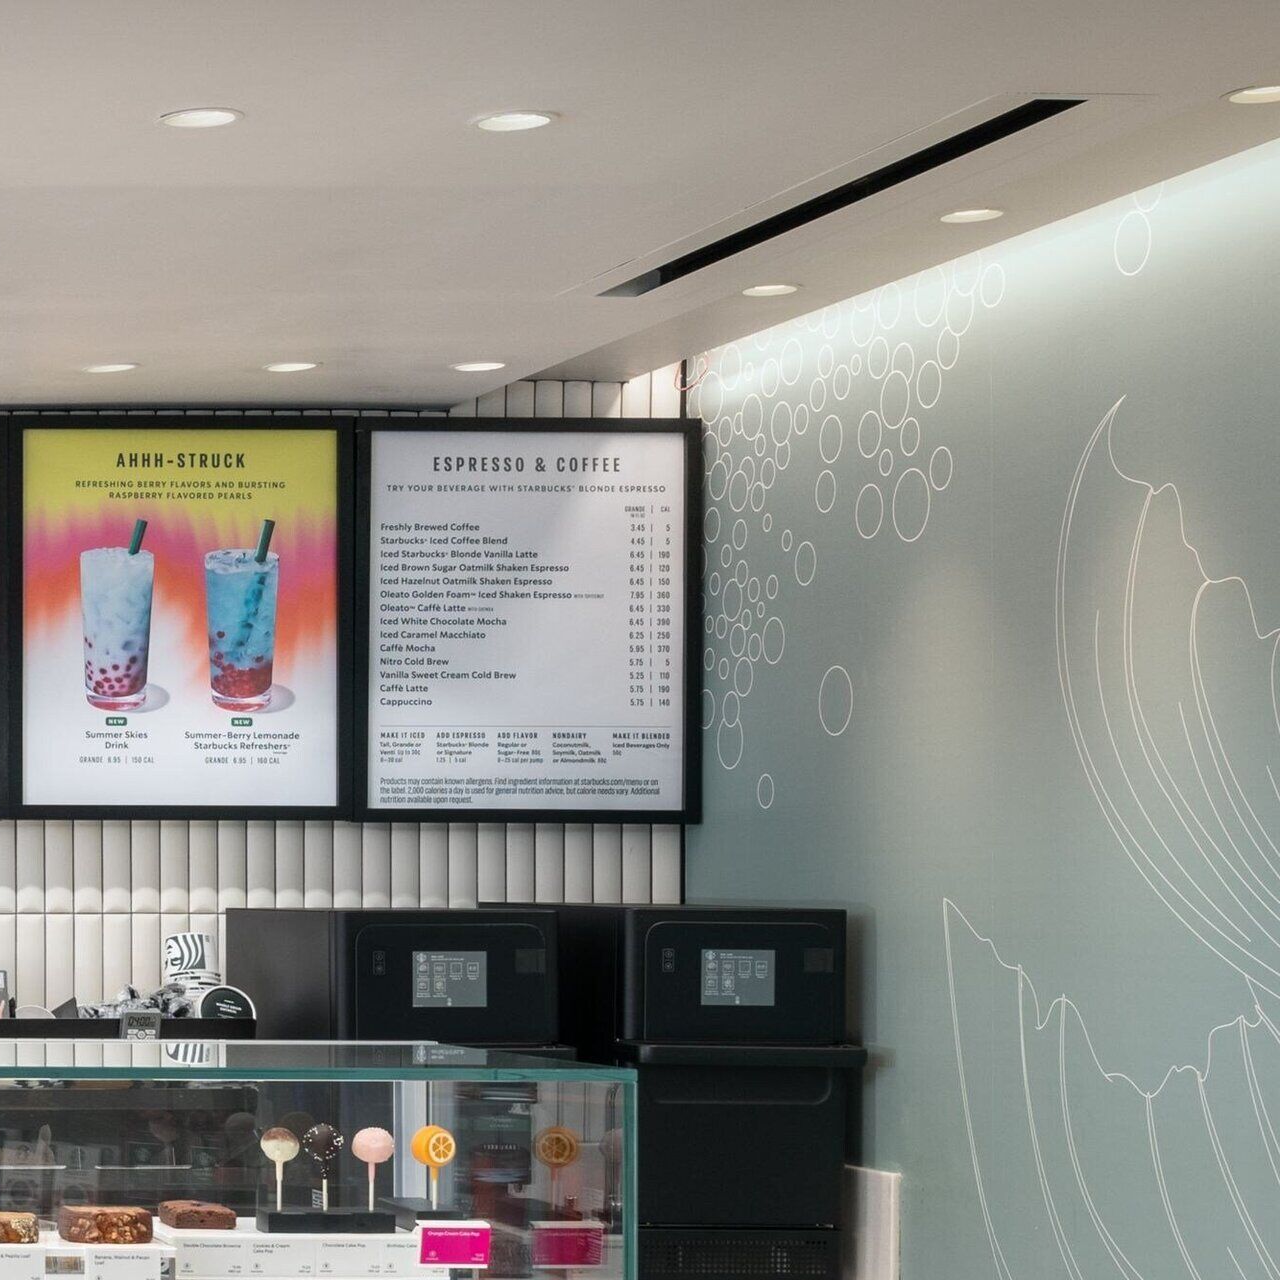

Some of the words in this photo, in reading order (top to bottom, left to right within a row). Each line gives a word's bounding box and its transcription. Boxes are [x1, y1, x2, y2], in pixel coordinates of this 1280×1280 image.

[116, 453, 246, 468] AHHH-STRUCK
[433, 456, 524, 472] ESPRESSO
[535, 456, 546, 472] &
[556, 456, 621, 472] COFFEE
[380, 523, 412, 532] Freshly
[414, 523, 448, 532] Brewed
[450, 523, 480, 532] Coffee
[380, 618, 398, 626] Iced
[401, 618, 428, 626] White
[430, 618, 474, 626] Chocolate
[476, 618, 506, 626] Mocha
[380, 658, 402, 666] Nitro
[404, 658, 424, 666] Cold
[427, 658, 449, 666] Brew
[380, 698, 432, 708] Cappuccino
[86, 731, 122, 739] Summer
[124, 731, 148, 739] Skies
[185, 732, 251, 741] Summer-Berry
[253, 732, 300, 740] Lemonade
[104, 742, 129, 750] Drink
